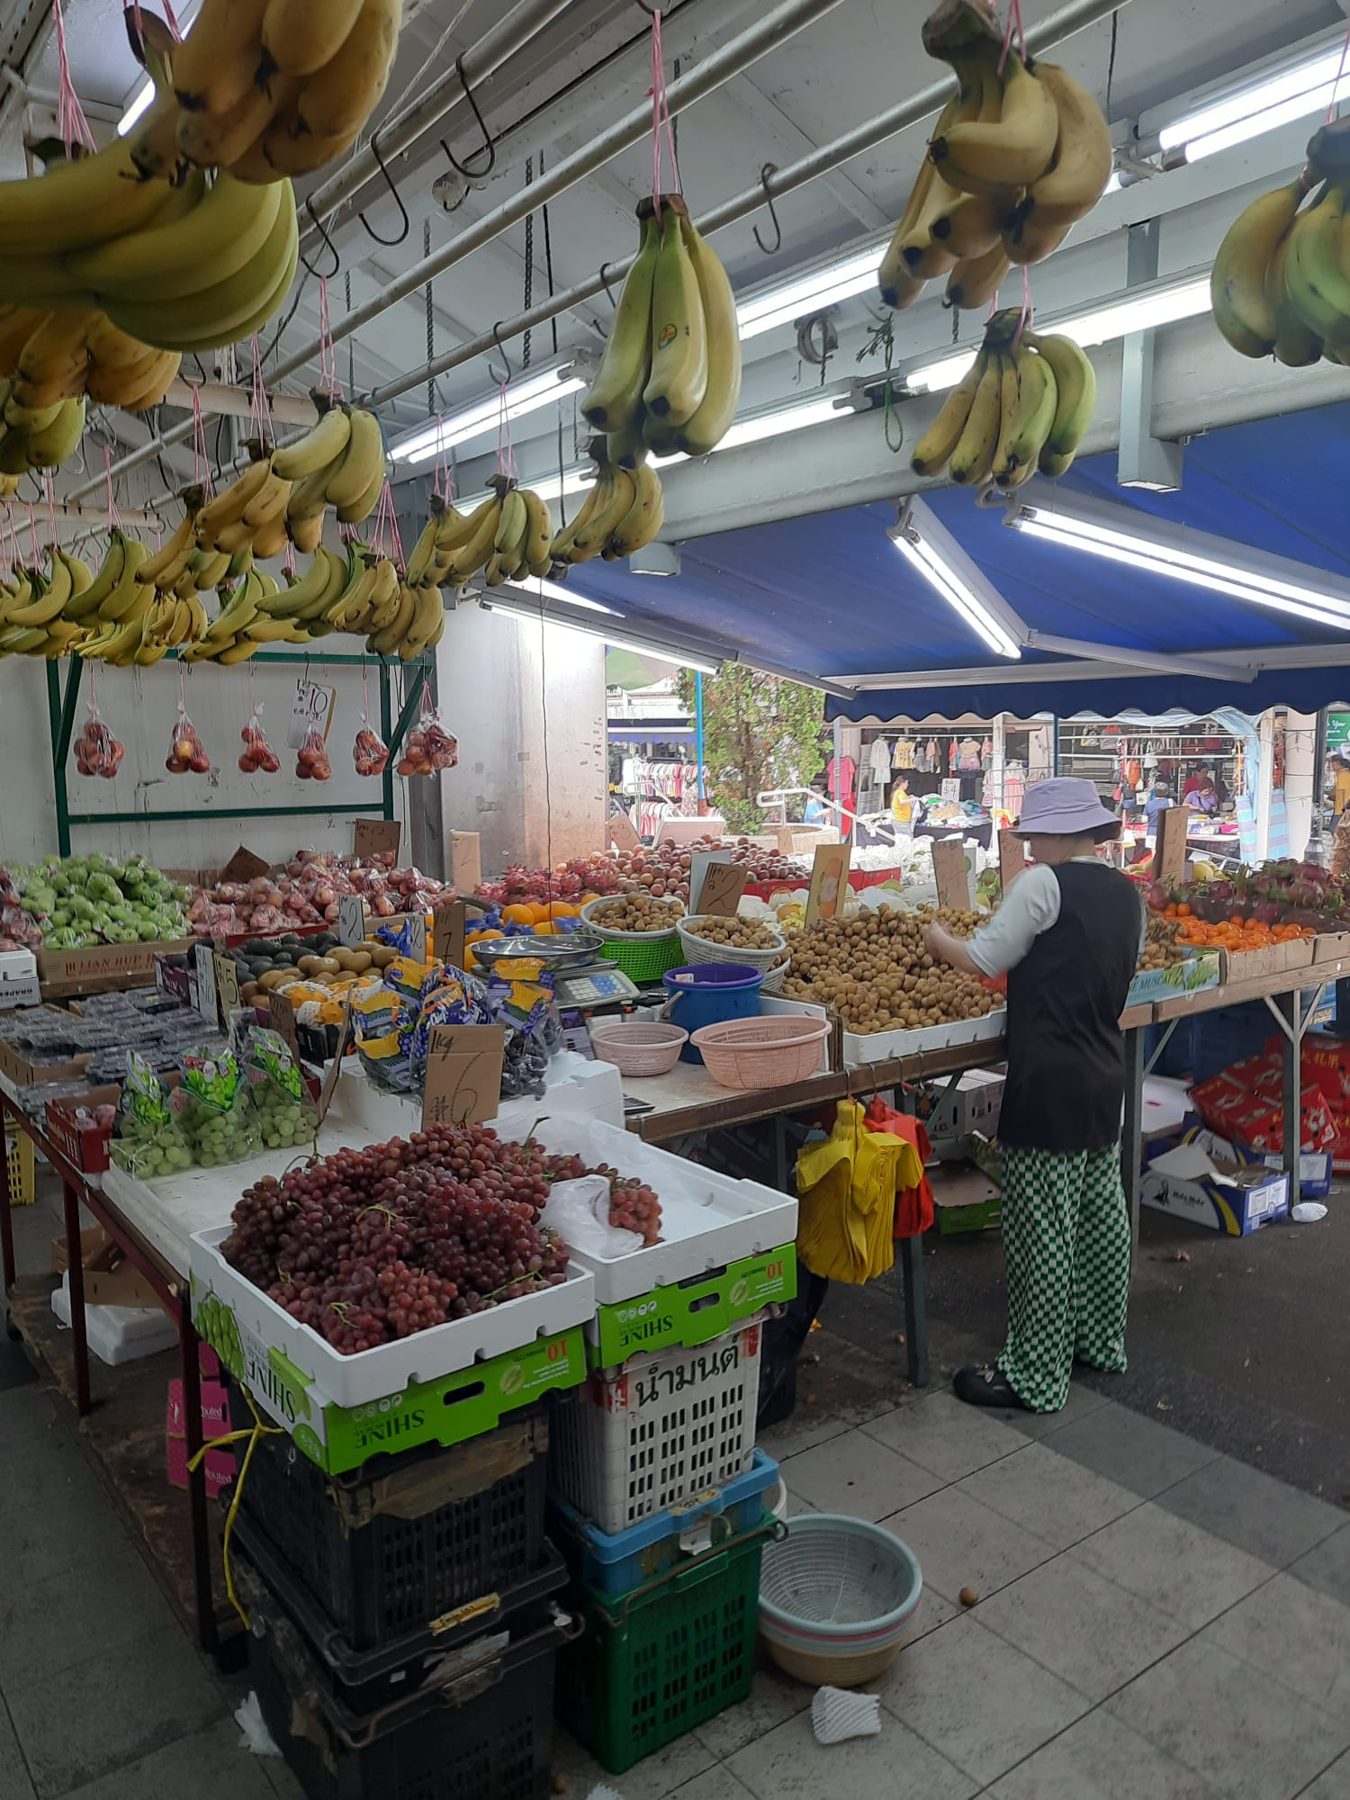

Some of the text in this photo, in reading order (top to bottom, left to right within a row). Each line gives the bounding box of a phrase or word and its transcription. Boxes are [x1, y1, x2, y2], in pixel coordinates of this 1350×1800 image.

[705, 868, 738, 911] 2
[348, 901, 362, 941] 2
[442, 931, 454, 966] 7
[225, 967, 238, 1005] 5
[767, 1260, 784, 1280] 10
[546, 1338, 568, 1362] 10
[620, 1315, 674, 1347] SHINE
[248, 1360, 296, 1424] SHINE
[355, 1409, 425, 1449] SHINE
